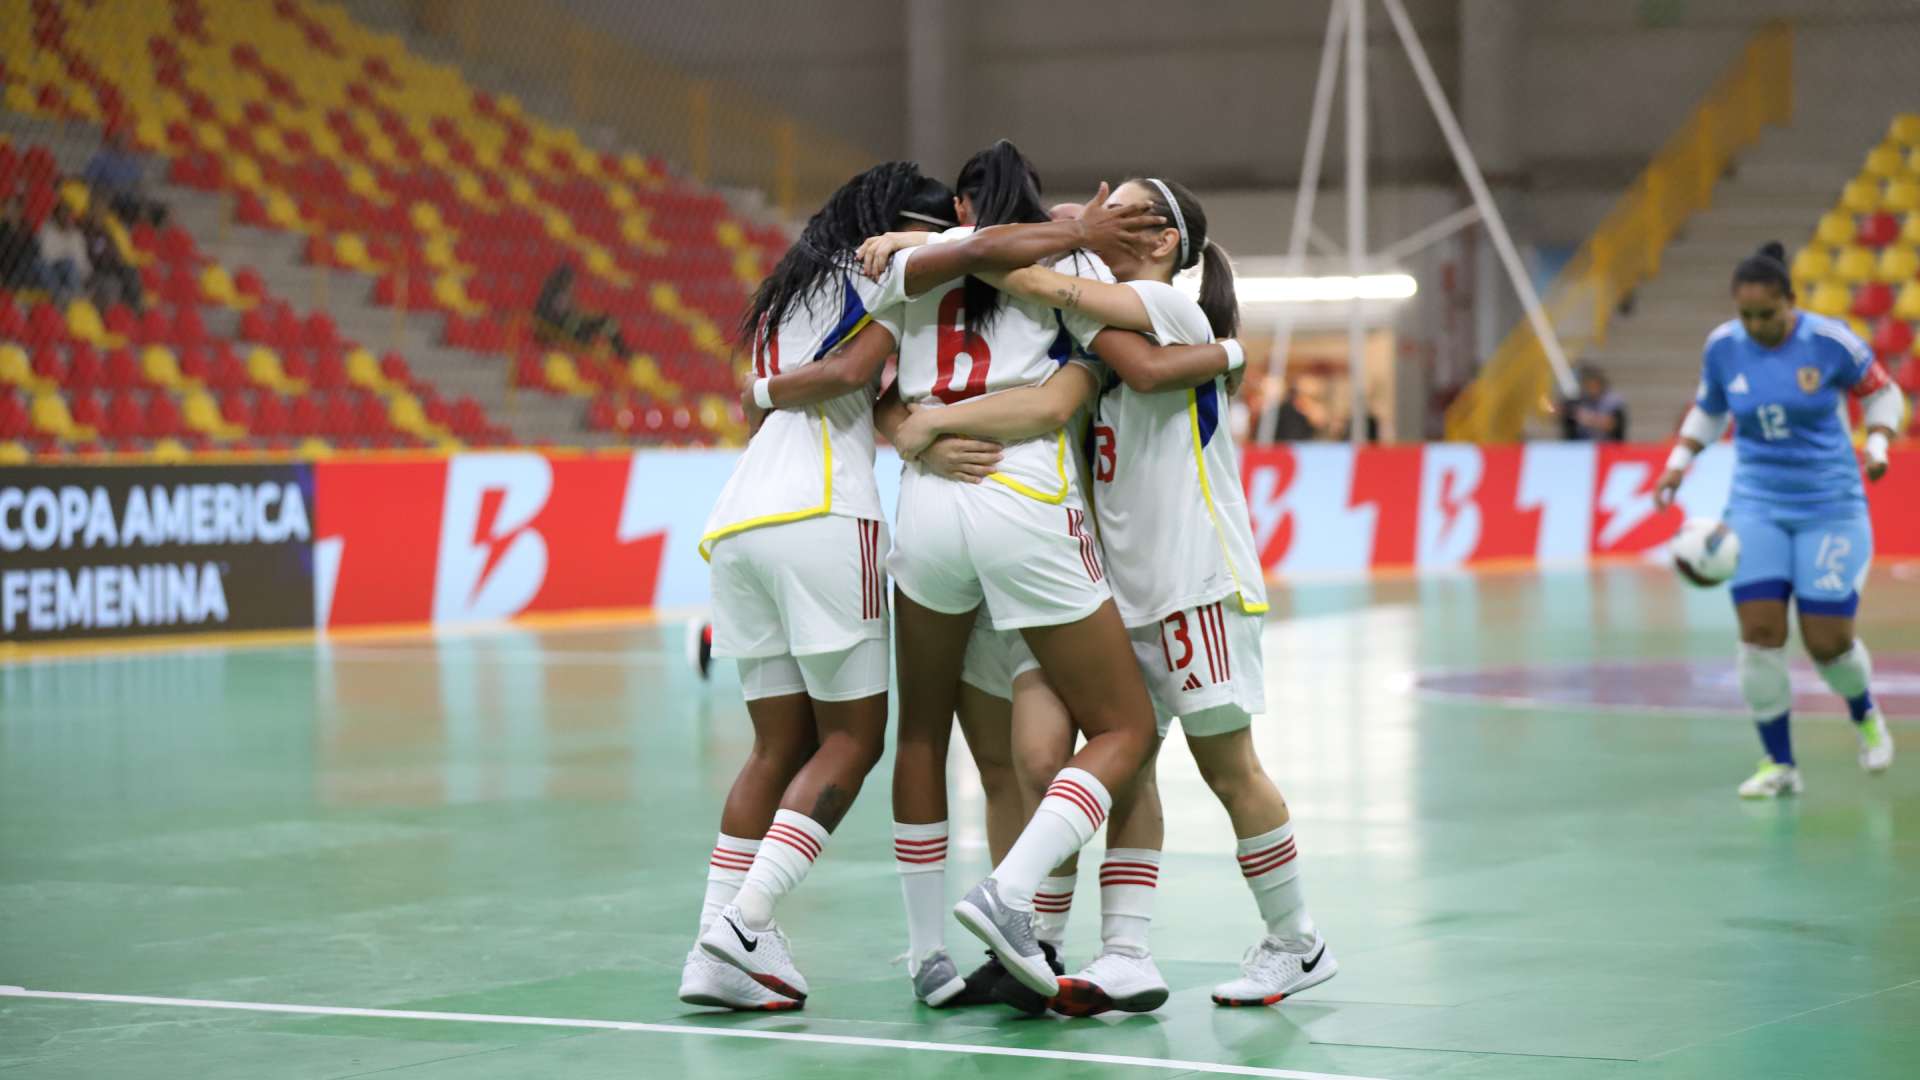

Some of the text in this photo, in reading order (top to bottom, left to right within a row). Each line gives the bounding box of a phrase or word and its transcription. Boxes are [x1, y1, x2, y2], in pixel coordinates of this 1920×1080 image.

[930, 287, 991, 405] 6
[1756, 404, 1790, 441] 12
[0, 482, 310, 550] COPA AMERICA
[1814, 533, 1850, 573] 12
[2, 562, 229, 633] FEMENINA
[1159, 609, 1194, 673] 13
